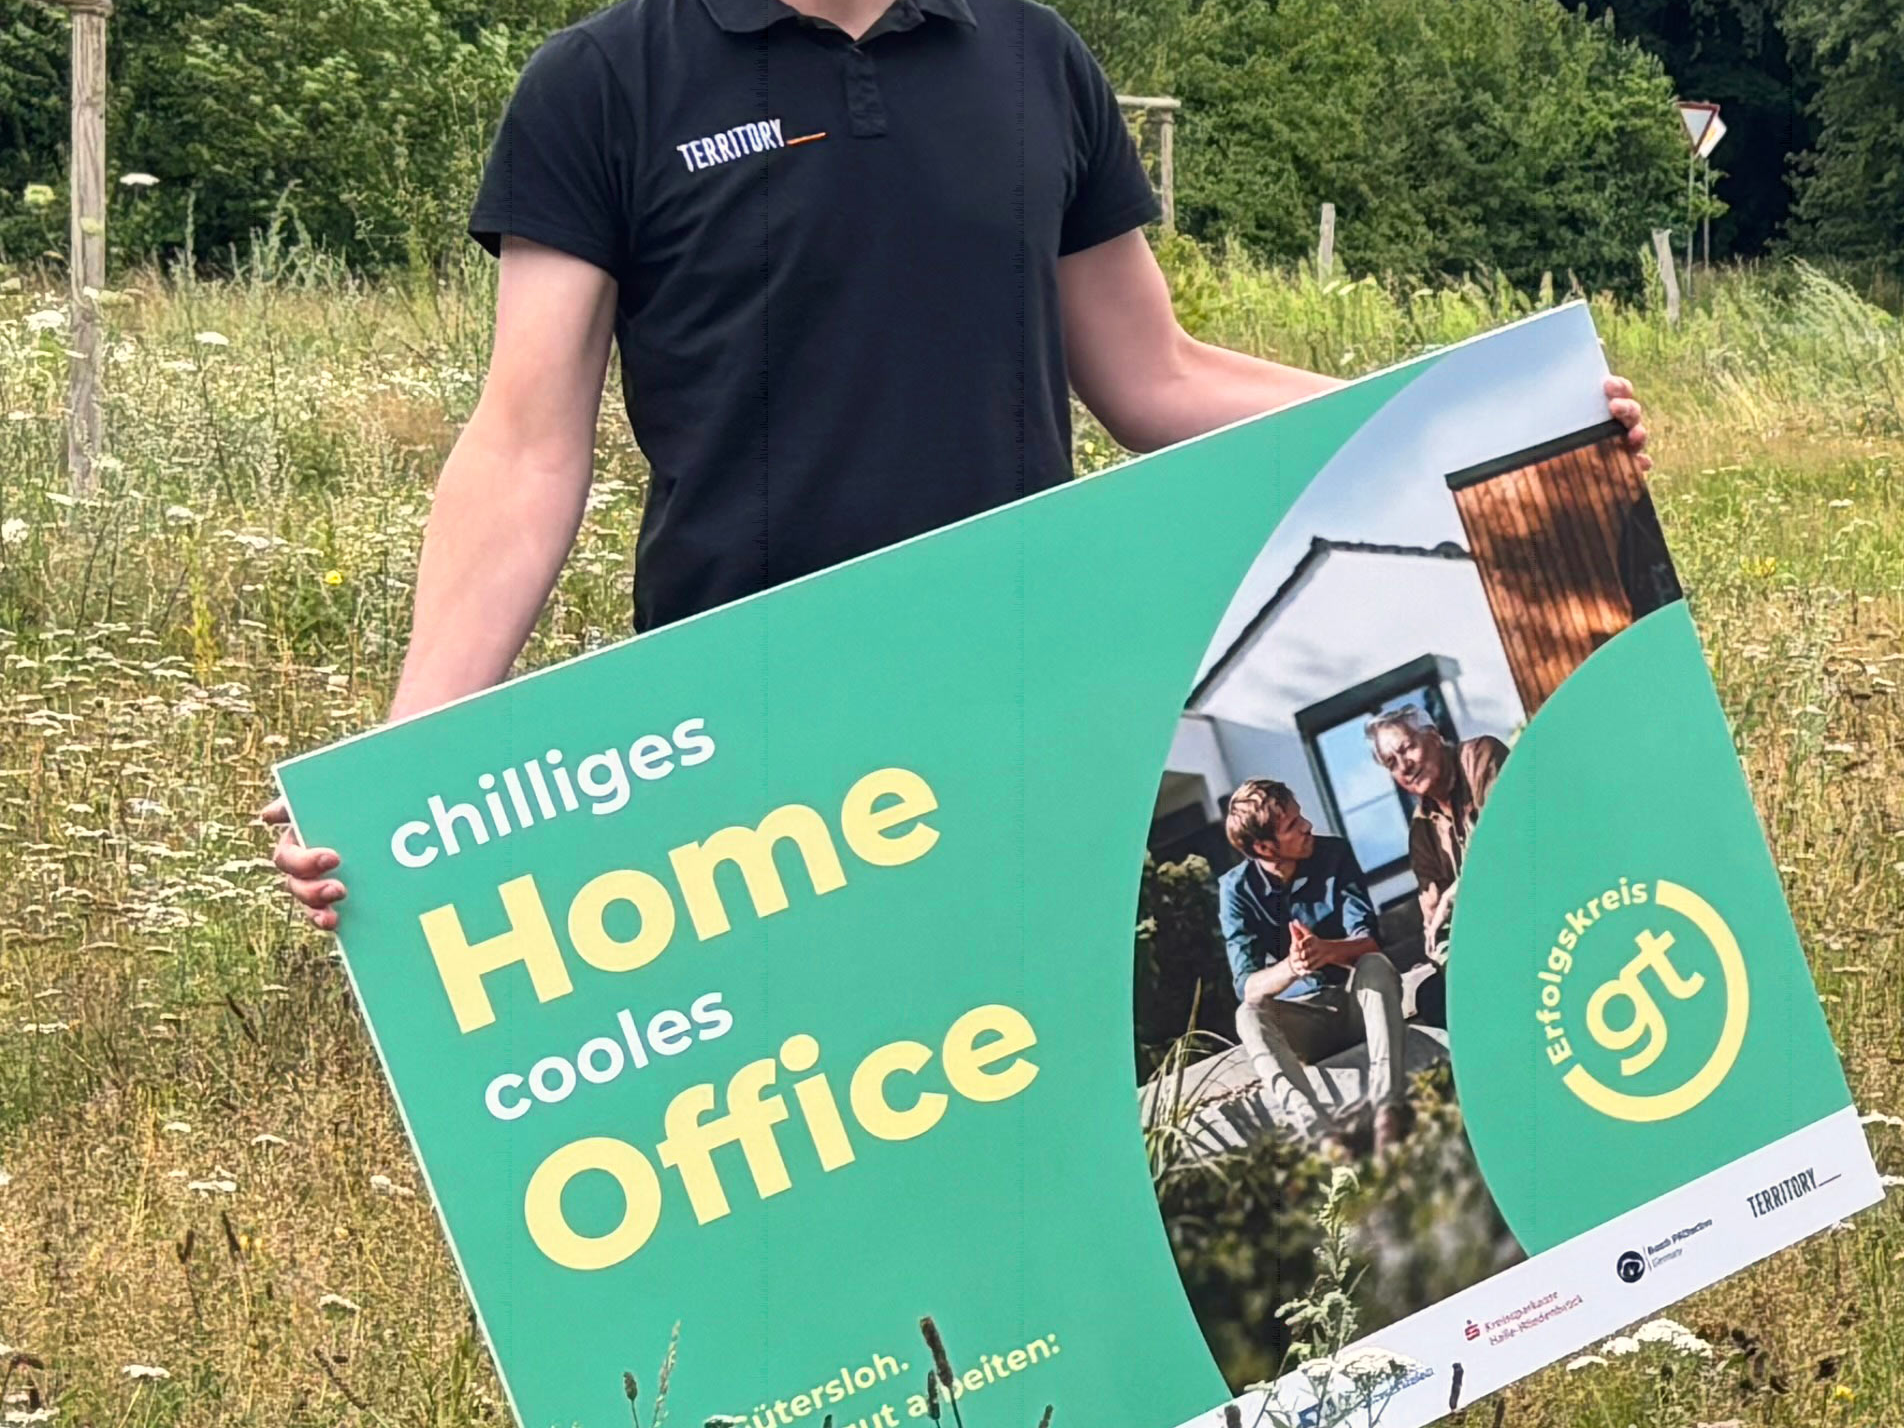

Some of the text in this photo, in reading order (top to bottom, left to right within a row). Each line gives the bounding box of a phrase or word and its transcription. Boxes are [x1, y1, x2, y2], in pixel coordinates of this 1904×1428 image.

[676, 118, 785, 173] TERRITORY
[389, 717, 717, 869] chilliges
[418, 766, 942, 1036] Home
[1535, 876, 1649, 1067] Erfolgskreis
[484, 991, 734, 1122] cooles
[1585, 928, 1706, 1077] gt
[523, 1003, 1041, 1271] Office
[1746, 1167, 1818, 1220] TERRITORY
[906, 1332, 1061, 1418] abeiten:
